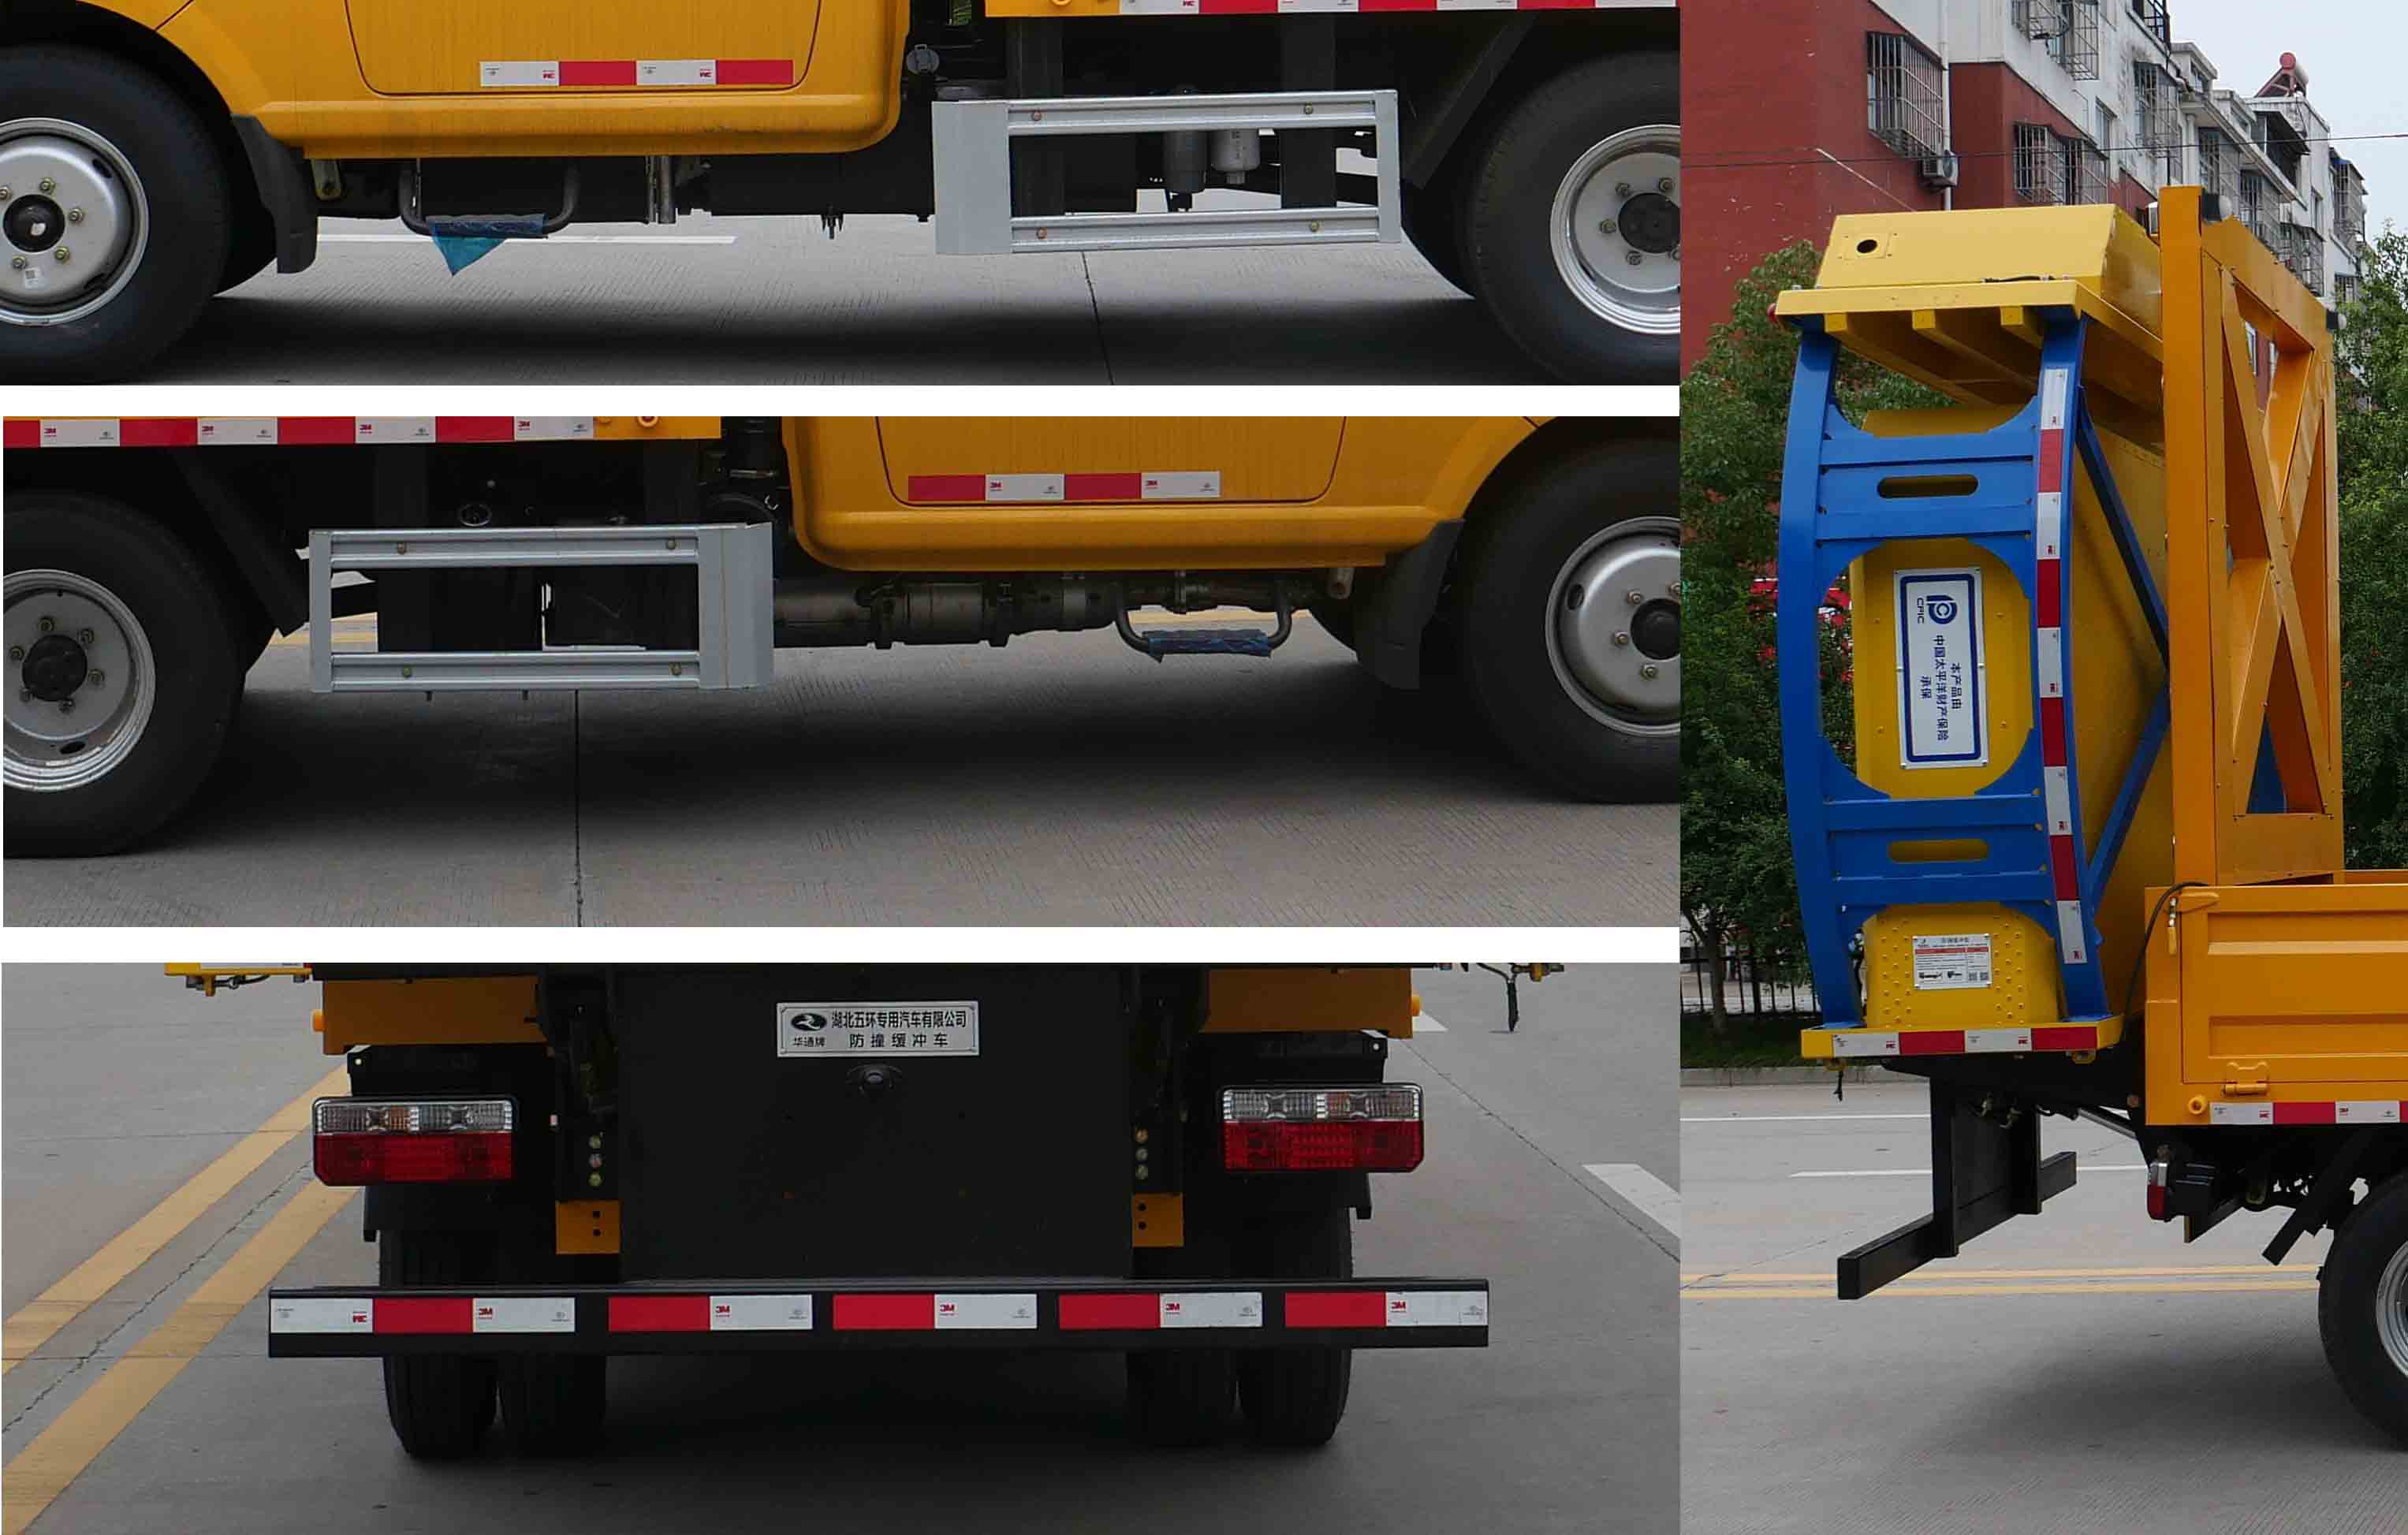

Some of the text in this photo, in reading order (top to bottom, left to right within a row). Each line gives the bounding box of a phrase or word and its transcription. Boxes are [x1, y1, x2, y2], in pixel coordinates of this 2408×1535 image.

[1920, 676, 1932, 699] 承保
[1933, 635, 1949, 741] 中国太平洋财产保险
[1950, 662, 1962, 710] 本产品由
[832, 1010, 966, 1029] 湖北五环专用汽车有限公司
[792, 1036, 826, 1048] 华通牌
[850, 1033, 949, 1048] 防撞缓冲车
[939, 1303, 955, 1312] 3M
[1165, 1302, 1180, 1311] 3M
[1390, 1301, 1407, 1310] 3M
